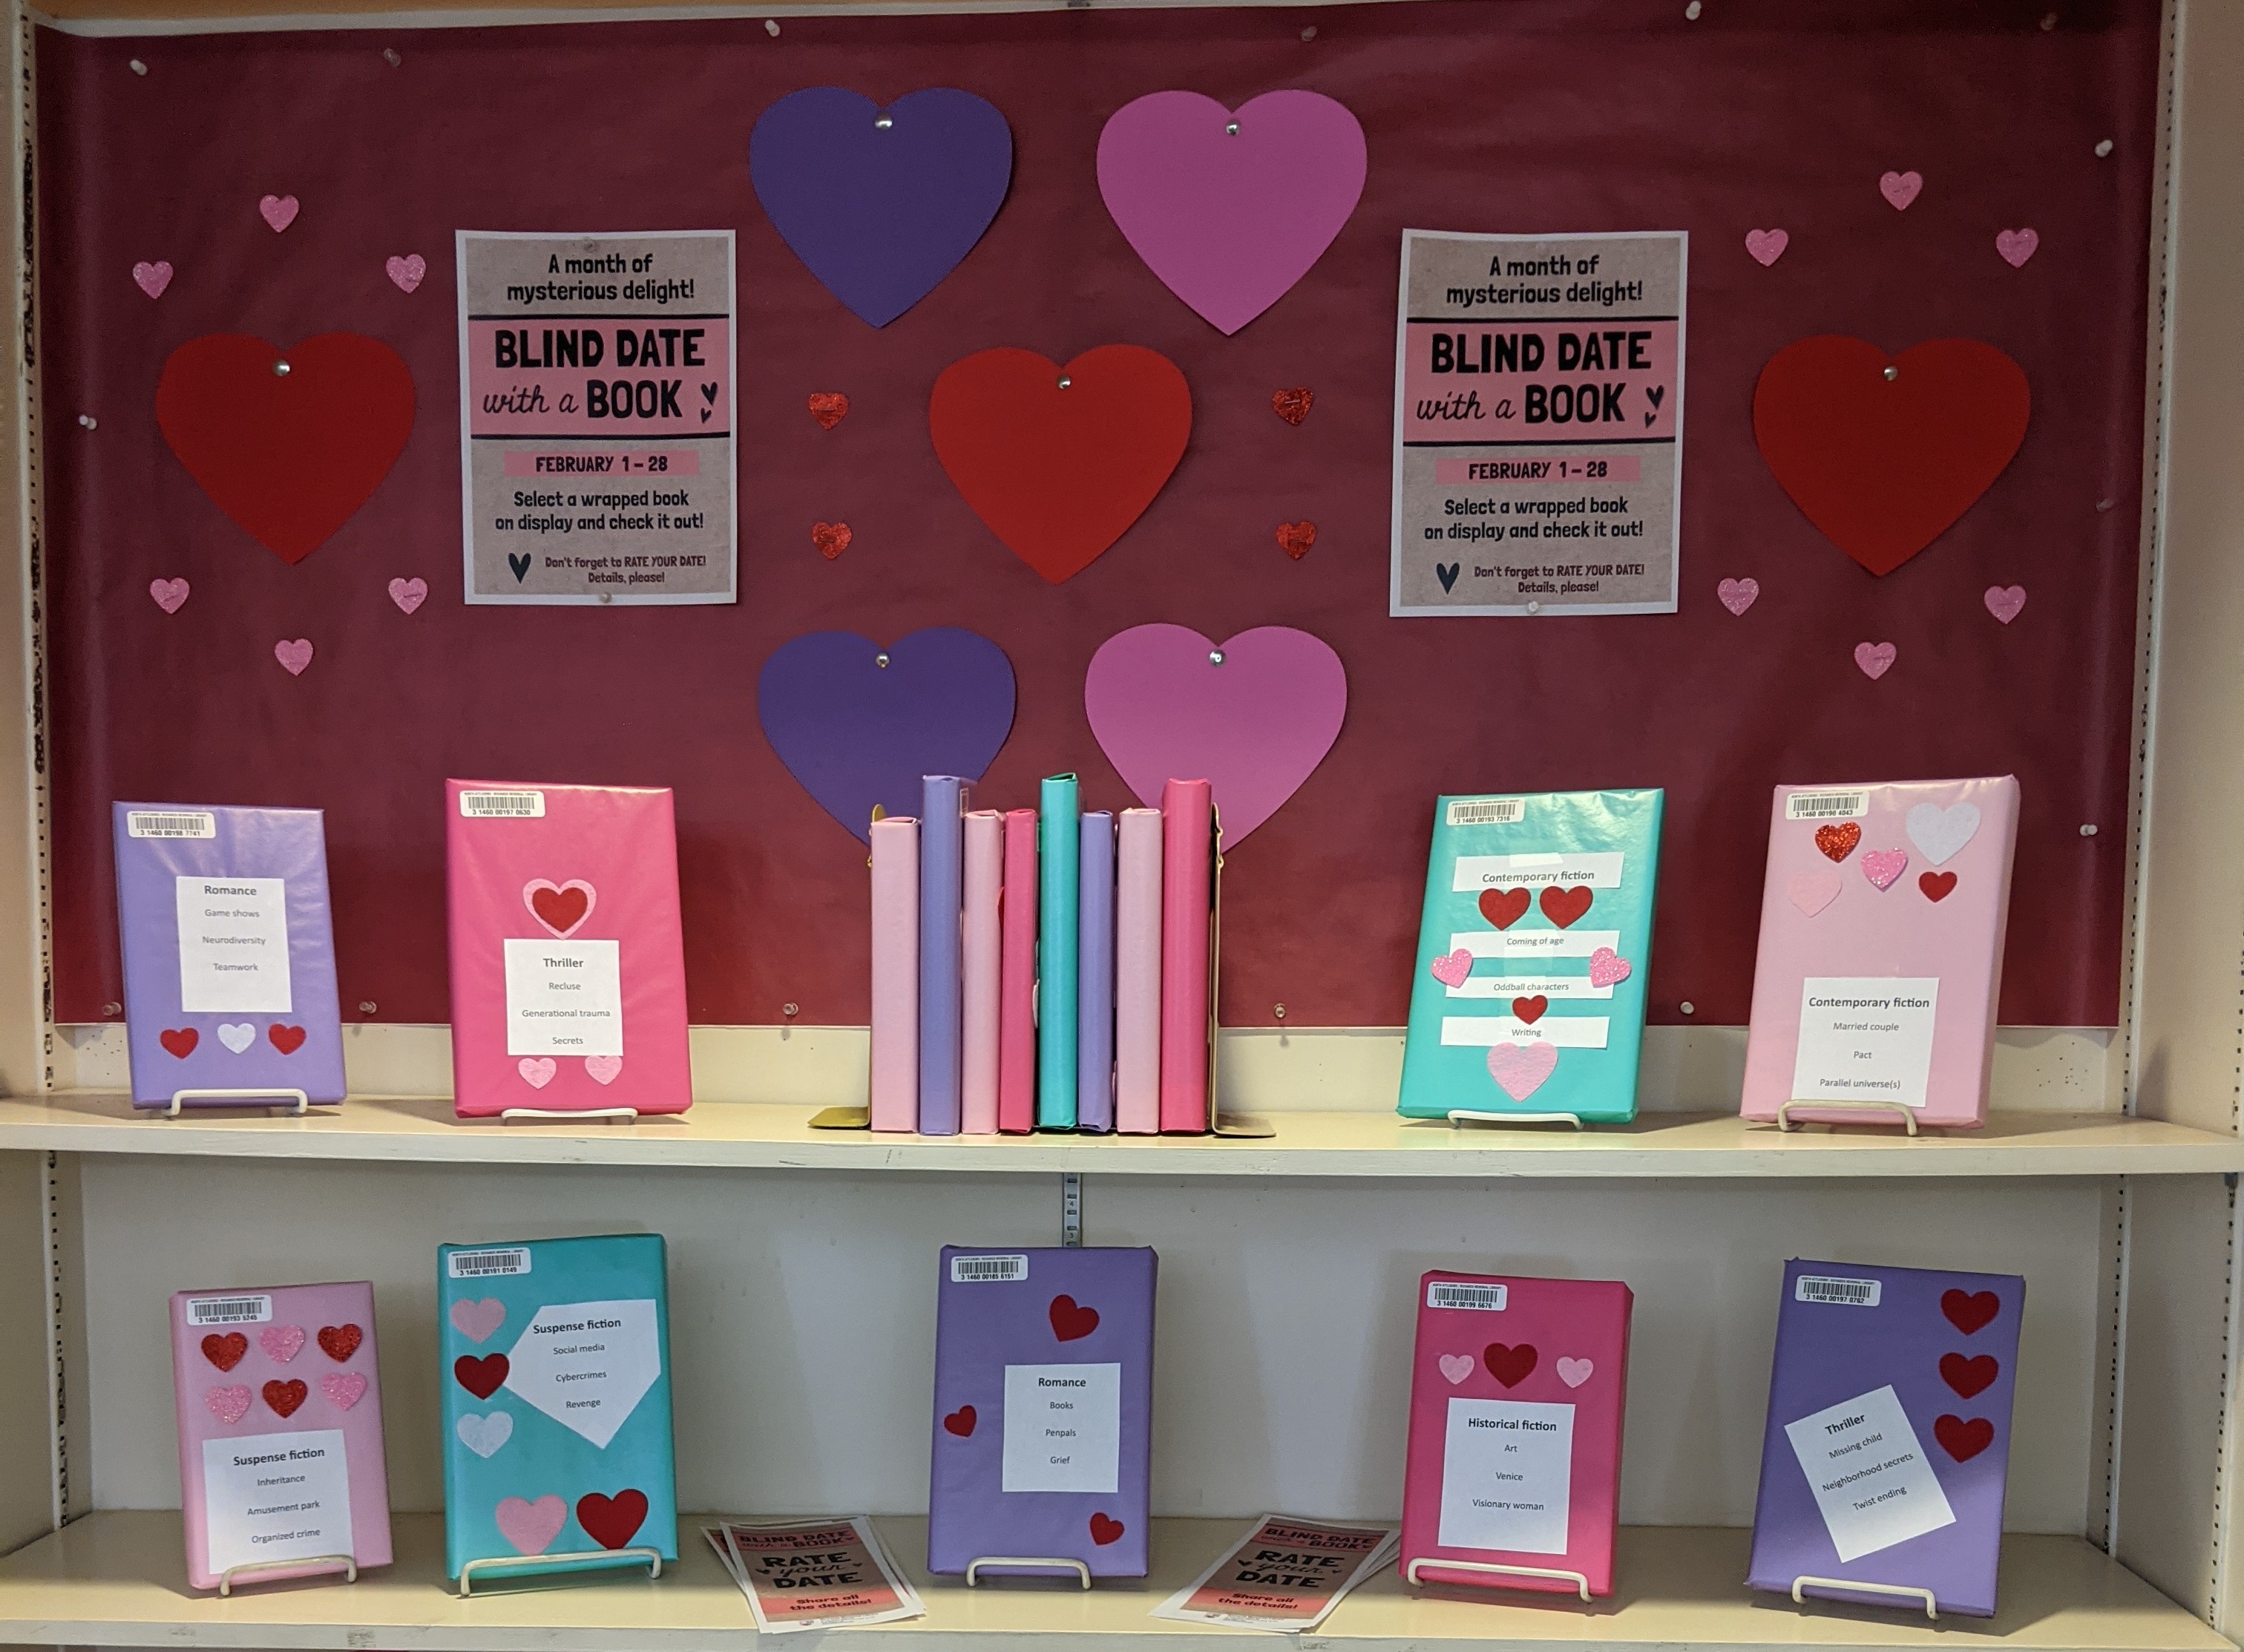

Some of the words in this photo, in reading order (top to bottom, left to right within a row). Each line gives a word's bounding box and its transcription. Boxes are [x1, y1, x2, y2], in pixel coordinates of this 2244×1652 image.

[548, 254, 560, 273] A
[565, 253, 626, 274] month
[632, 253, 653, 273] of
[1489, 256, 1501, 276] A
[1507, 255, 1571, 276] month
[1577, 255, 1600, 275] of
[508, 280, 617, 305] mysterious
[623, 278, 694, 304] delight!
[1446, 283, 1561, 308] mysterious
[1566, 280, 1642, 307] delight!
[495, 330, 604, 368] BLIND
[617, 329, 705, 367] DATE
[1431, 333, 1545, 373] BLIND
[1558, 331, 1652, 371] DATE
[483, 384, 550, 413] with
[559, 393, 579, 413] a
[587, 379, 683, 419] BOOK
[1417, 390, 1486, 420] with
[1495, 399, 1516, 419] a
[1525, 382, 1627, 424] BOOK
[536, 456, 614, 472] FEBRUARY
[622, 456, 629, 472] 1
[649, 456, 668, 471] 28
[1469, 462, 1552, 479] FEBRUARY
[1559, 462, 1566, 478] 1
[1587, 461, 1607, 477] 28
[514, 491, 563, 507] Select
[568, 495, 577, 506] a
[581, 490, 649, 511] wrapped
[653, 489, 689, 506] book
[1445, 498, 1496, 515] Select
[1500, 502, 1509, 514] a
[1515, 496, 1585, 518] wrapped
[1590, 496, 1628, 513] book
[496, 518, 514, 530] on
[518, 514, 573, 534] display
[577, 514, 605, 530] and
[609, 513, 654, 529] check
[657, 513, 670, 529] it
[674, 513, 703, 529] out!
[1425, 528, 1443, 540] on
[1448, 522, 1505, 543] display
[1509, 521, 1538, 538] and
[1543, 521, 1590, 538] check
[1594, 520, 1607, 537] it
[1611, 520, 1643, 537] out!
[545, 557, 572, 568] Don't
[574, 557, 608, 570] forget
[611, 557, 622, 568] to
[624, 556, 649, 567] RATE
[652, 556, 678, 567] YOUR
[680, 555, 706, 566] DATE!
[1474, 566, 1502, 577] Don't
[1504, 566, 1540, 580] forget
[1542, 566, 1554, 577] to
[1557, 565, 1583, 577] RATE
[1585, 565, 1613, 576] YOUR
[1616, 564, 1644, 575] DATE!
[588, 571, 626, 584] Details,
[629, 571, 665, 586] please!
[1518, 581, 1558, 594] Details,
[1561, 580, 1598, 595] please!
[1483, 873, 1558, 883] Contemporary
[1561, 871, 1594, 880] fiction
[204, 885, 257, 896] Romance
[232, 909, 260, 917] shows
[203, 936, 266, 945] Neurodiversity
[1506, 938, 1538, 946] Coming
[213, 963, 258, 971] Teamwork
[543, 958, 584, 968] Thriller
[549, 982, 581, 990] Recluse
[1809, 997, 1890, 1009] Contemporary
[1894, 997, 1929, 1007] fiction
[1512, 1029, 1541, 1038] Writing
[1870, 1023, 1899, 1032] couple
[1854, 1051, 1872, 1059] Pact
[1820, 1078, 1851, 1086] Parallel
[1853, 1080, 1900, 1089] universe(s)
[534, 1323, 584, 1334] Suspense
[587, 1319, 621, 1329] fiction
[553, 1345, 577, 1354] Social
[580, 1343, 605, 1352] media
[556, 1371, 607, 1383] Cybercrimes
[1038, 1377, 1086, 1387] Romance
[566, 1400, 601, 1409] Revenge
[1050, 1401, 1074, 1409] Books
[1469, 1418, 1519, 1429] Historical
[1522, 1420, 1556, 1431] fiction
[1825, 1415, 1864, 1435] Thriller
[1046, 1429, 1076, 1438] Penpals
[1504, 1444, 1518, 1452] Art
[1828, 1443, 1862, 1458] Missing
[1862, 1432, 1883, 1446] child
[234, 1454, 286, 1466] Suspense
[289, 1449, 324, 1460] fiction
[1050, 1456, 1070, 1464] Grief
[1495, 1472, 1523, 1481] Venice
[1823, 1463, 1883, 1492] Neighborhood
[1883, 1454, 1914, 1469] secrets
[257, 1475, 305, 1486] Inheritance
[1472, 1499, 1511, 1510] Visionary
[1852, 1498, 1876, 1510] Twist
[1877, 1487, 1907, 1502] ending
[247, 1504, 299, 1515] Amusement
[301, 1501, 320, 1511] park
[252, 1531, 295, 1544] Organized
[297, 1530, 321, 1538] crime
[803, 1530, 851, 1541] DATE
[1327, 1535, 1376, 1544] DATE
[793, 1538, 842, 1547] BOOK
[1308, 1540, 1362, 1550] BOOK
[762, 1552, 851, 1567] RATE
[1255, 1550, 1345, 1567] RATE
[773, 1572, 862, 1588] DATE
[1236, 1570, 1325, 1588] DATE
[796, 1596, 839, 1605] Share
[816, 1599, 872, 1608] details!
[1232, 1593, 1273, 1602] Share
[1218, 1598, 1243, 1606] the
[1244, 1600, 1299, 1610] details!
